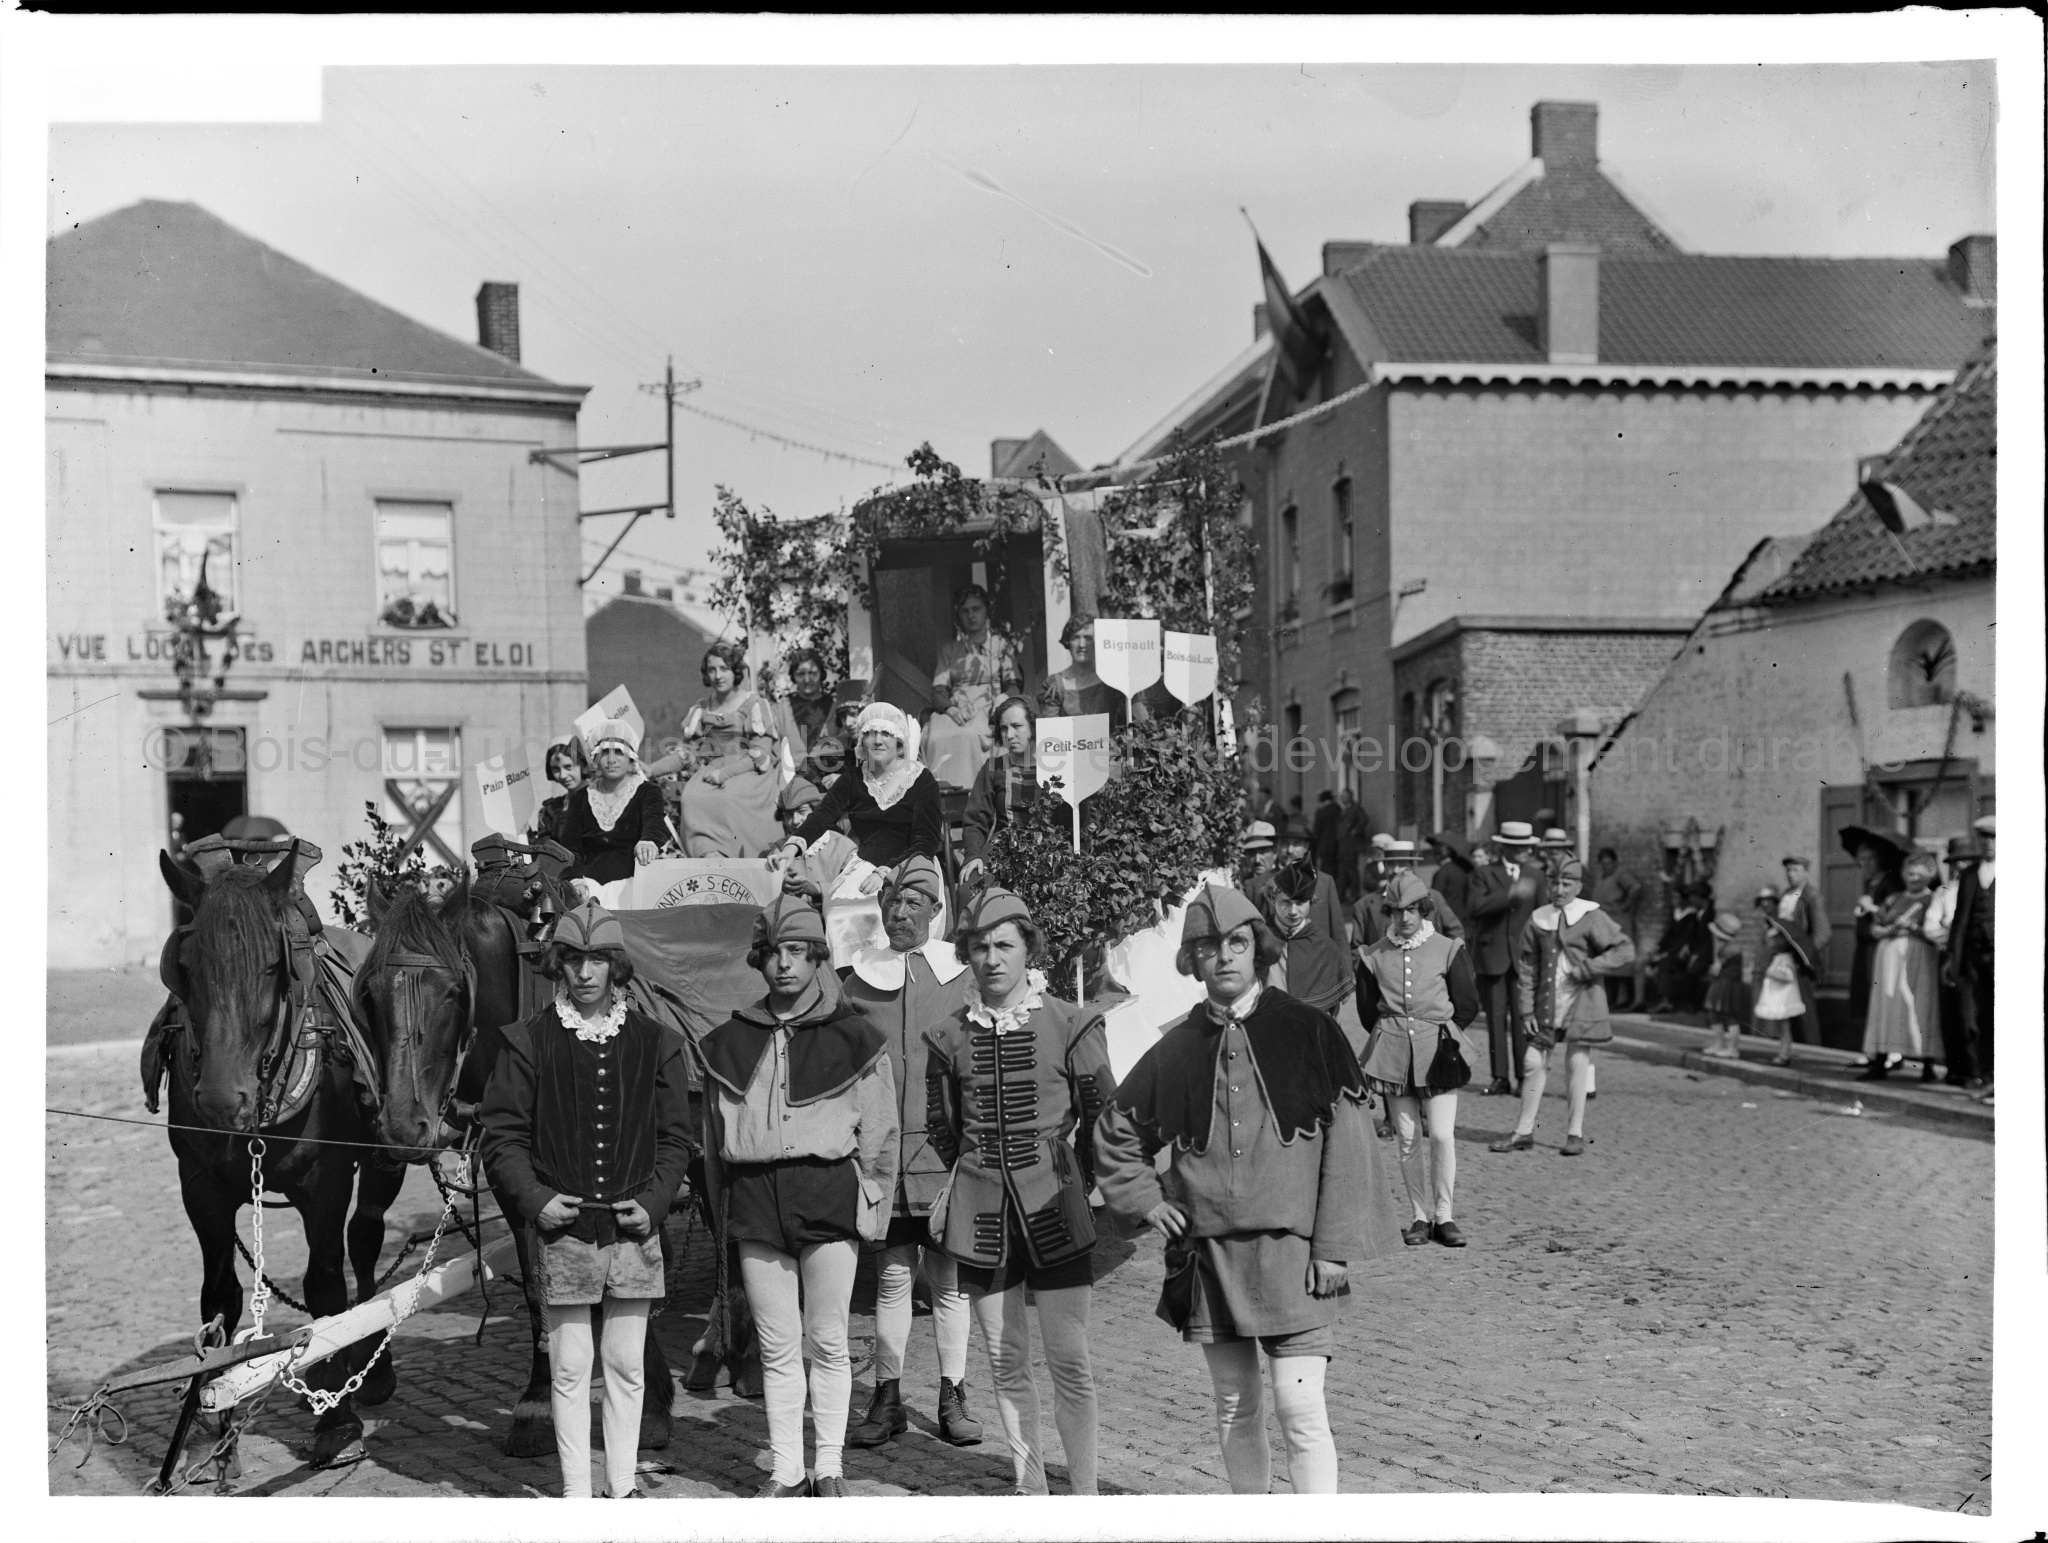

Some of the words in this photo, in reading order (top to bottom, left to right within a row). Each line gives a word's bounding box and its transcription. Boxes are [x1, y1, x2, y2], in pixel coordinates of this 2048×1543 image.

[57, 634, 107, 660] VUE
[302, 639, 411, 665] ARCHERS
[430, 642, 460, 666] ST
[475, 642, 532, 667] ELOI
[1103, 639, 1155, 651] Bignault
[1043, 738, 1104, 753] Petit-Sart
[482, 779, 504, 795] Pain
[505, 767, 530, 786] Blanc
